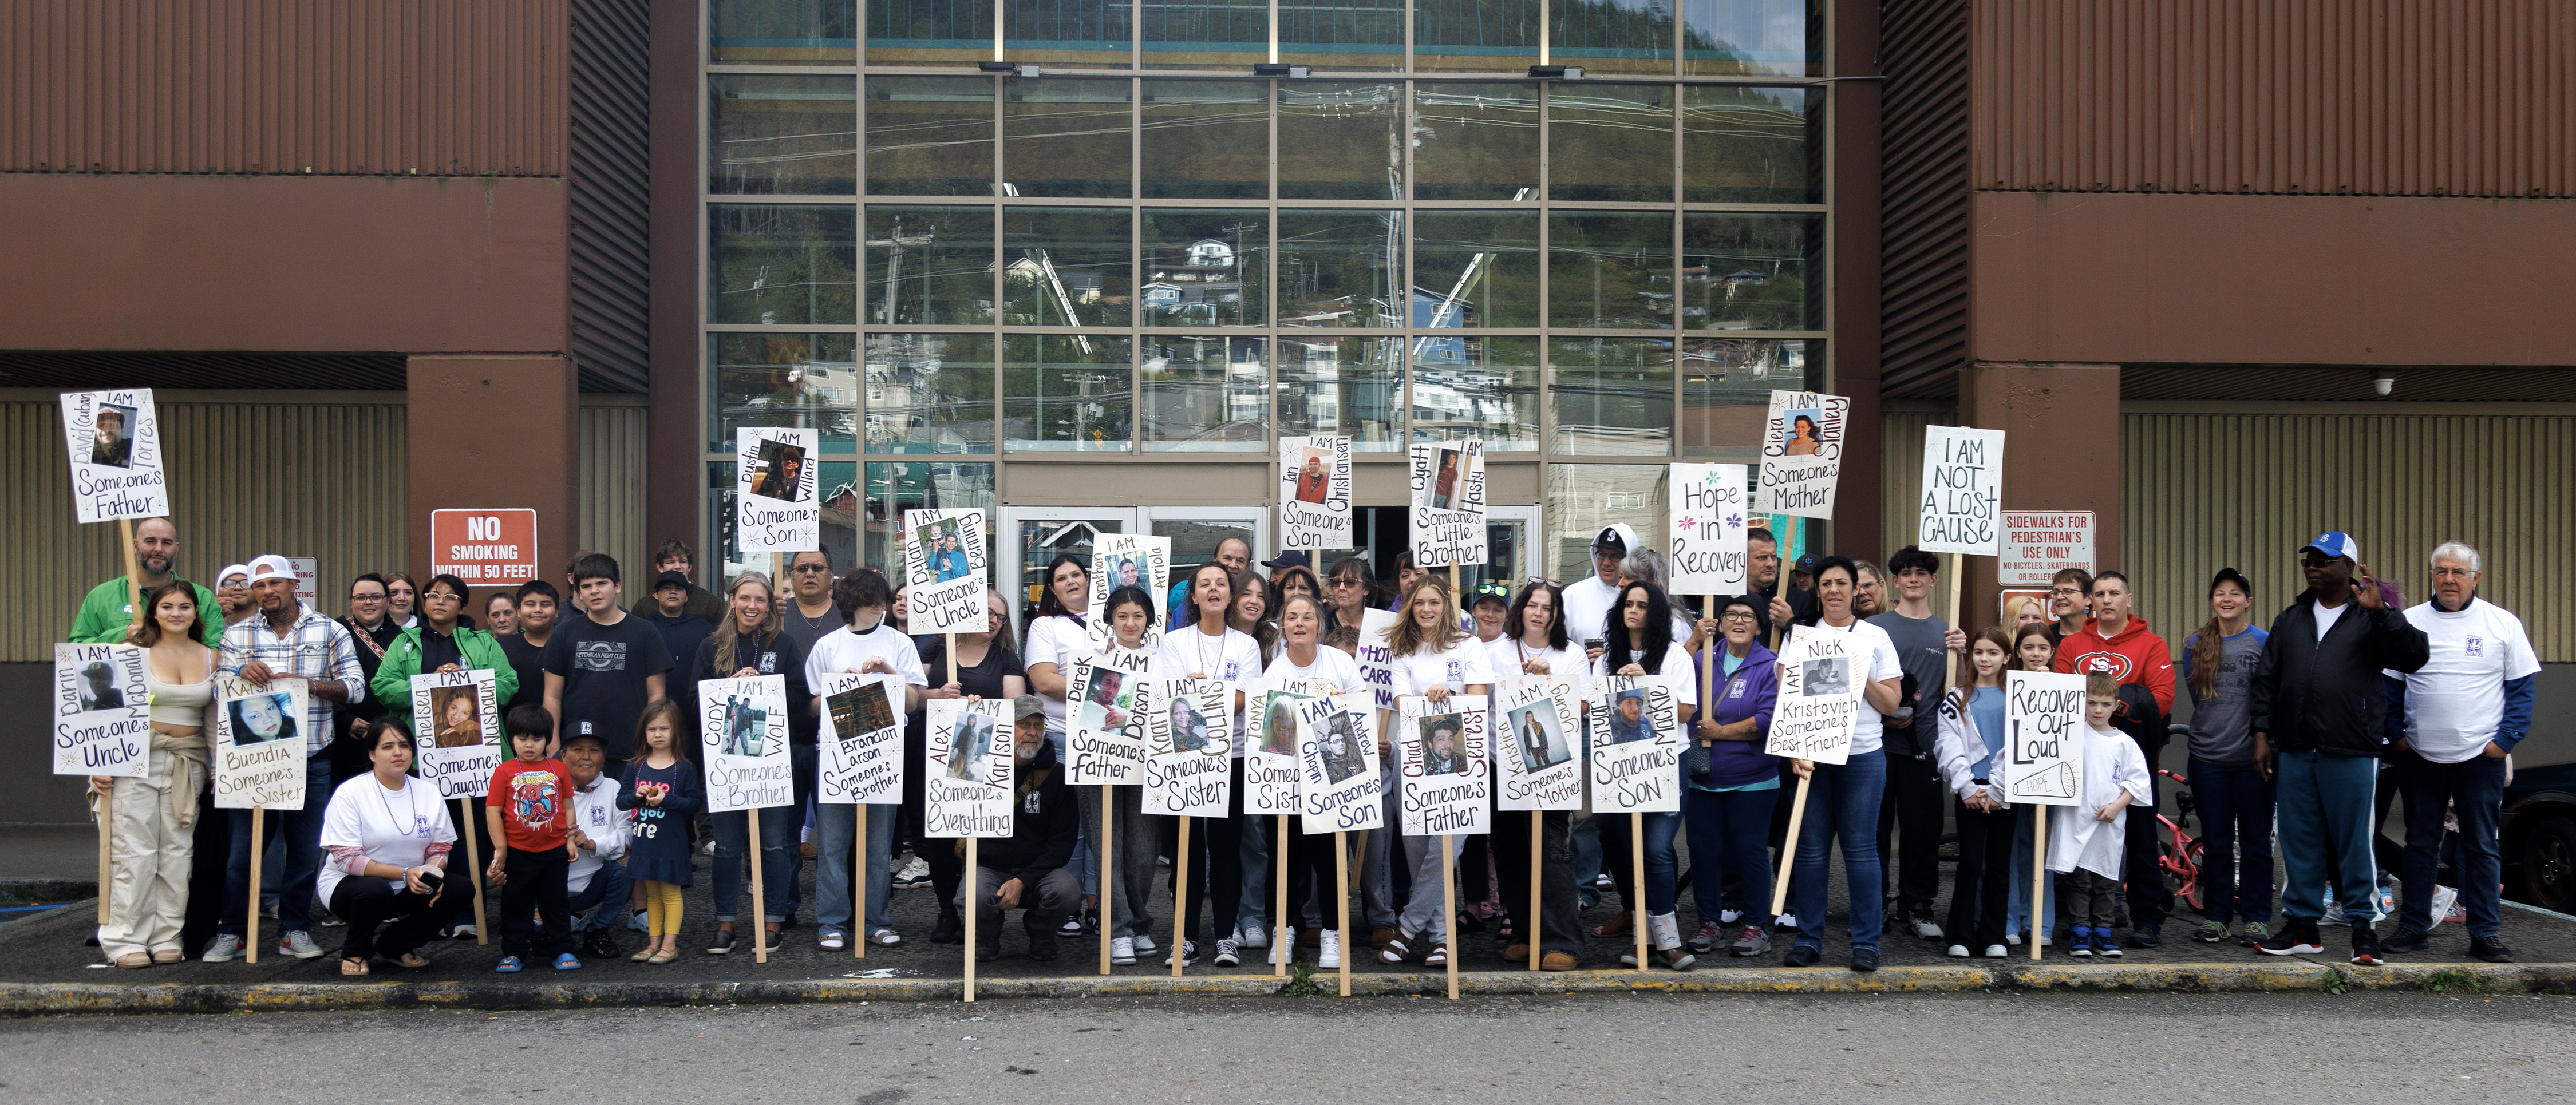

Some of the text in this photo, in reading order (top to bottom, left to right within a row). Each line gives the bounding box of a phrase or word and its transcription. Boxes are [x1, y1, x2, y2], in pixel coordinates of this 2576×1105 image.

[114, 393, 133, 406] AM
[1790, 395, 1819, 409] I AM
[775, 430, 800, 445] I AM
[1316, 437, 1333, 449] AM
[1764, 418, 1784, 457] Ciera
[1813, 398, 1848, 461] Stanley
[131, 418, 156, 470] Torres
[1460, 441, 1483, 457] I AM
[1945, 438, 1984, 465] I AM
[741, 445, 759, 483] Dustin
[1283, 466, 1298, 484] Ian
[1327, 438, 1349, 512] Christiansen
[1411, 445, 1431, 490] Wyatt
[1763, 462, 1838, 486] Someone's
[79, 469, 163, 496] Someone's
[796, 458, 816, 503] Willard
[1934, 465, 1985, 491] NOT
[96, 490, 155, 519] Father
[1459, 471, 1485, 514] Hasty
[1685, 482, 1740, 520] Hope
[1775, 484, 1830, 510] Mother
[1922, 490, 1938, 514] A
[742, 501, 818, 526] Someone's
[912, 509, 942, 526] I AM
[1283, 501, 1351, 531] Someone's
[1417, 507, 1480, 529] Someone's
[2006, 516, 2087, 528] SIDEWALKS FOR
[468, 517, 501, 541] NO
[764, 525, 797, 545] Son
[958, 512, 986, 570] Benning
[1287, 525, 1321, 546] Son
[1436, 524, 1473, 542] Little
[1701, 516, 1721, 540] in
[2012, 532, 2081, 543] PEDESTRIAN'S
[2320, 534, 2330, 542] S
[451, 545, 518, 560] SMOKING
[1108, 537, 1136, 552] I AM
[1419, 541, 1484, 565] Brother
[2022, 547, 2071, 559] USE ONLY
[436, 564, 534, 578] WITHIN 50 FEET
[907, 540, 929, 585] Dylan
[1149, 547, 1166, 588] Arriola
[1672, 538, 1745, 584] Recovery
[2014, 562, 2045, 570] BICYCLES,
[913, 577, 984, 613] Someone's
[933, 600, 979, 628] Uncle
[77, 646, 112, 661] I AM
[1119, 653, 1149, 672] AM
[59, 668, 81, 716] Darin
[116, 648, 149, 718] McDonald
[441, 671, 471, 686] I AM
[737, 681, 762, 695] I AM
[829, 676, 860, 694] I AM
[1167, 680, 1171, 698] I
[1283, 679, 1307, 694] I AM
[1606, 677, 1611, 693] I
[974, 699, 1001, 717] AM
[1422, 700, 1426, 716] I
[1510, 684, 1543, 707] I AM
[1783, 695, 1859, 719] Kristovich
[2012, 679, 2085, 716] Recover
[416, 690, 434, 748] Chelsea
[704, 697, 726, 746] CODY
[1123, 682, 1149, 740] Dotson
[1246, 695, 1266, 743] TONYA
[57, 720, 148, 748] Someone's
[765, 706, 785, 757] WOLF
[1148, 710, 1173, 757] Kaari
[1350, 711, 1375, 756] Andrew
[1773, 716, 1848, 738] Someone's
[84, 738, 139, 767] Uncle
[840, 727, 898, 755] Brandon
[1072, 729, 1145, 763] Someone's
[1456, 706, 1487, 778] Secrest
[1499, 721, 1525, 778] Kristina
[1771, 728, 1847, 758] Best Friend
[2013, 719, 2059, 765] Loud
[832, 750, 882, 774] Larson
[985, 724, 1012, 790] Karlson
[1302, 741, 1323, 784] Chapin
[1401, 739, 1424, 777] Chad
[1594, 747, 1676, 785] Someone's
[219, 767, 293, 794] Someone's
[438, 772, 489, 797] Daught
[710, 758, 792, 786] Someone's
[824, 761, 891, 796] Someone's
[1506, 766, 1573, 801] Someone's
[2026, 773, 2052, 793] HOPE
[252, 784, 304, 804] Sister
[729, 782, 789, 807] Brother
[850, 773, 899, 802] Brother
[929, 778, 1002, 802] Someone's
[1167, 775, 1226, 811] Sister
[1307, 778, 1381, 815] Someone's
[1405, 781, 1486, 812] Someone's
[1536, 779, 1581, 808] Mother
[640, 808, 665, 821] you
[1338, 804, 1377, 829] Son
[1424, 804, 1478, 834] Father
